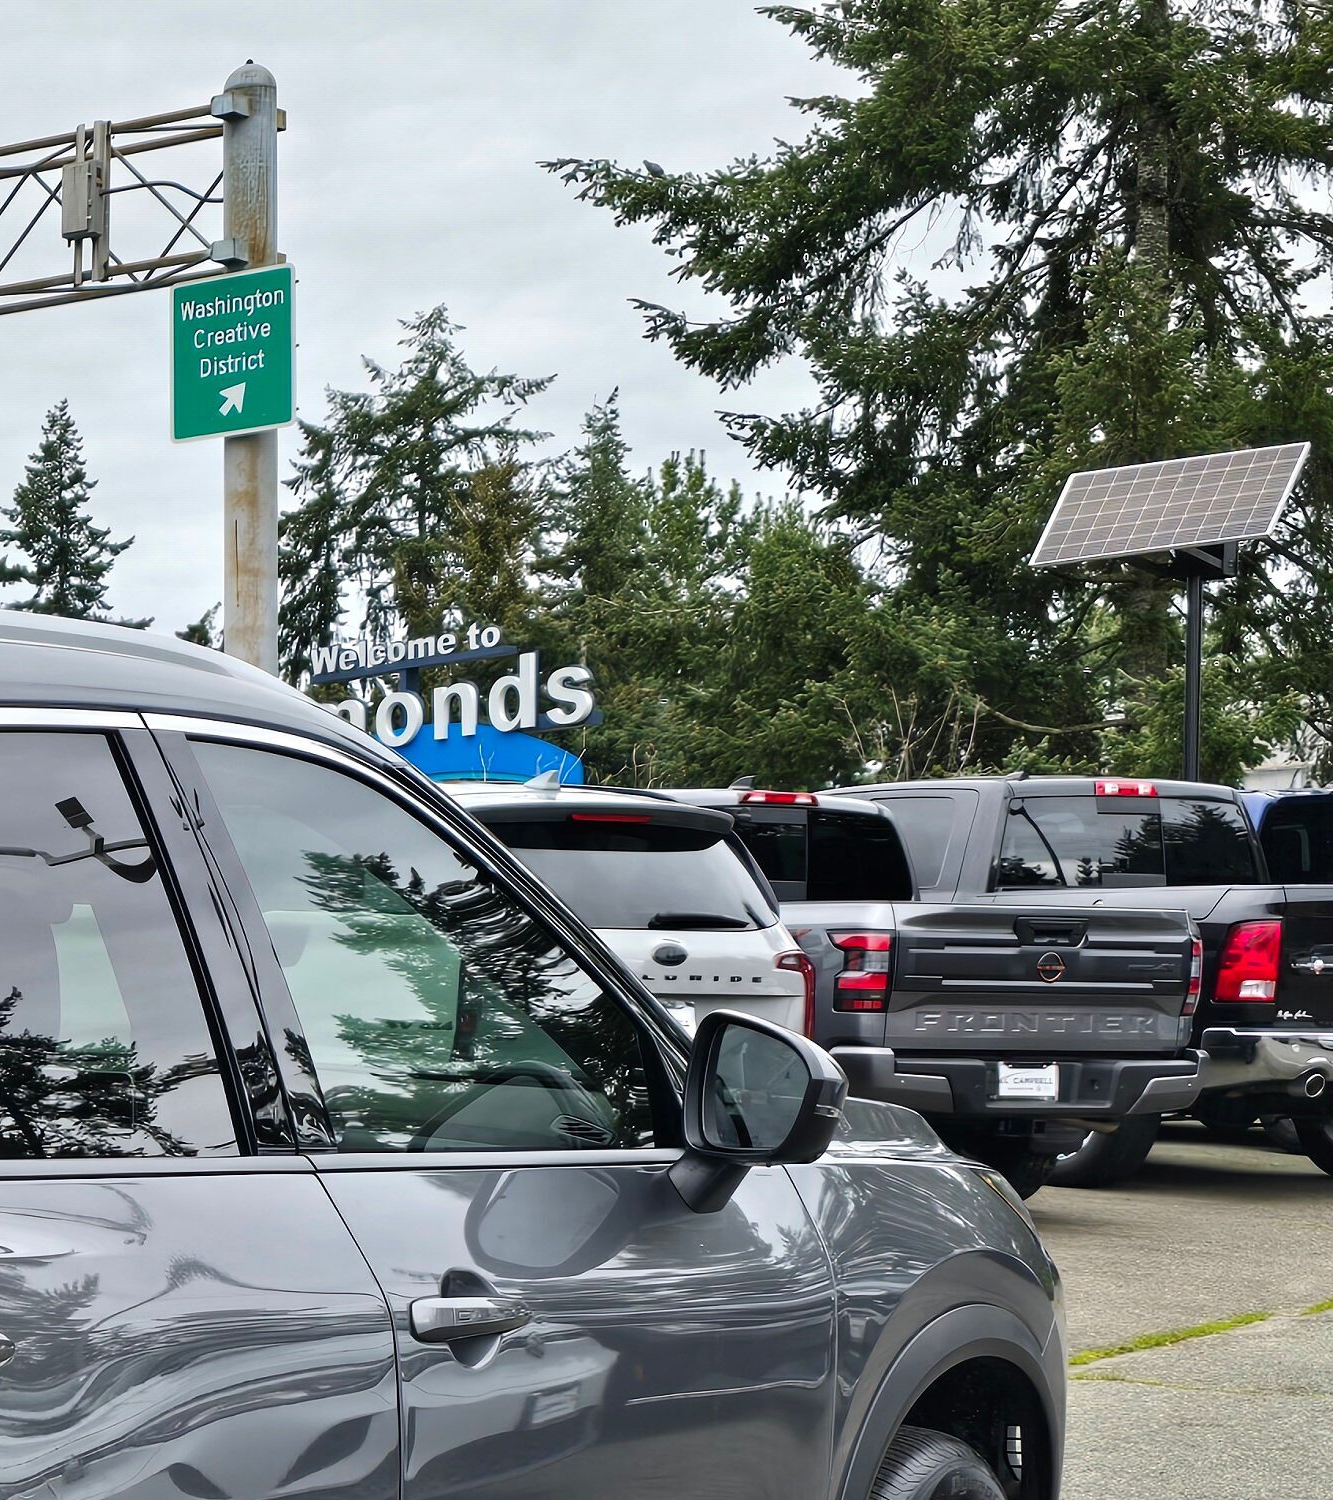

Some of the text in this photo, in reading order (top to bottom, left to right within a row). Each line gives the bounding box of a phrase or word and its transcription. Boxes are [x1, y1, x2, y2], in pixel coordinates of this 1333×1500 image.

[181, 289, 284, 321] Washington
[194, 322, 271, 349] Creative
[200, 349, 265, 378] District
[309, 622, 502, 676] Welcome to
[914, 1010, 1155, 1034] FRONTIER
